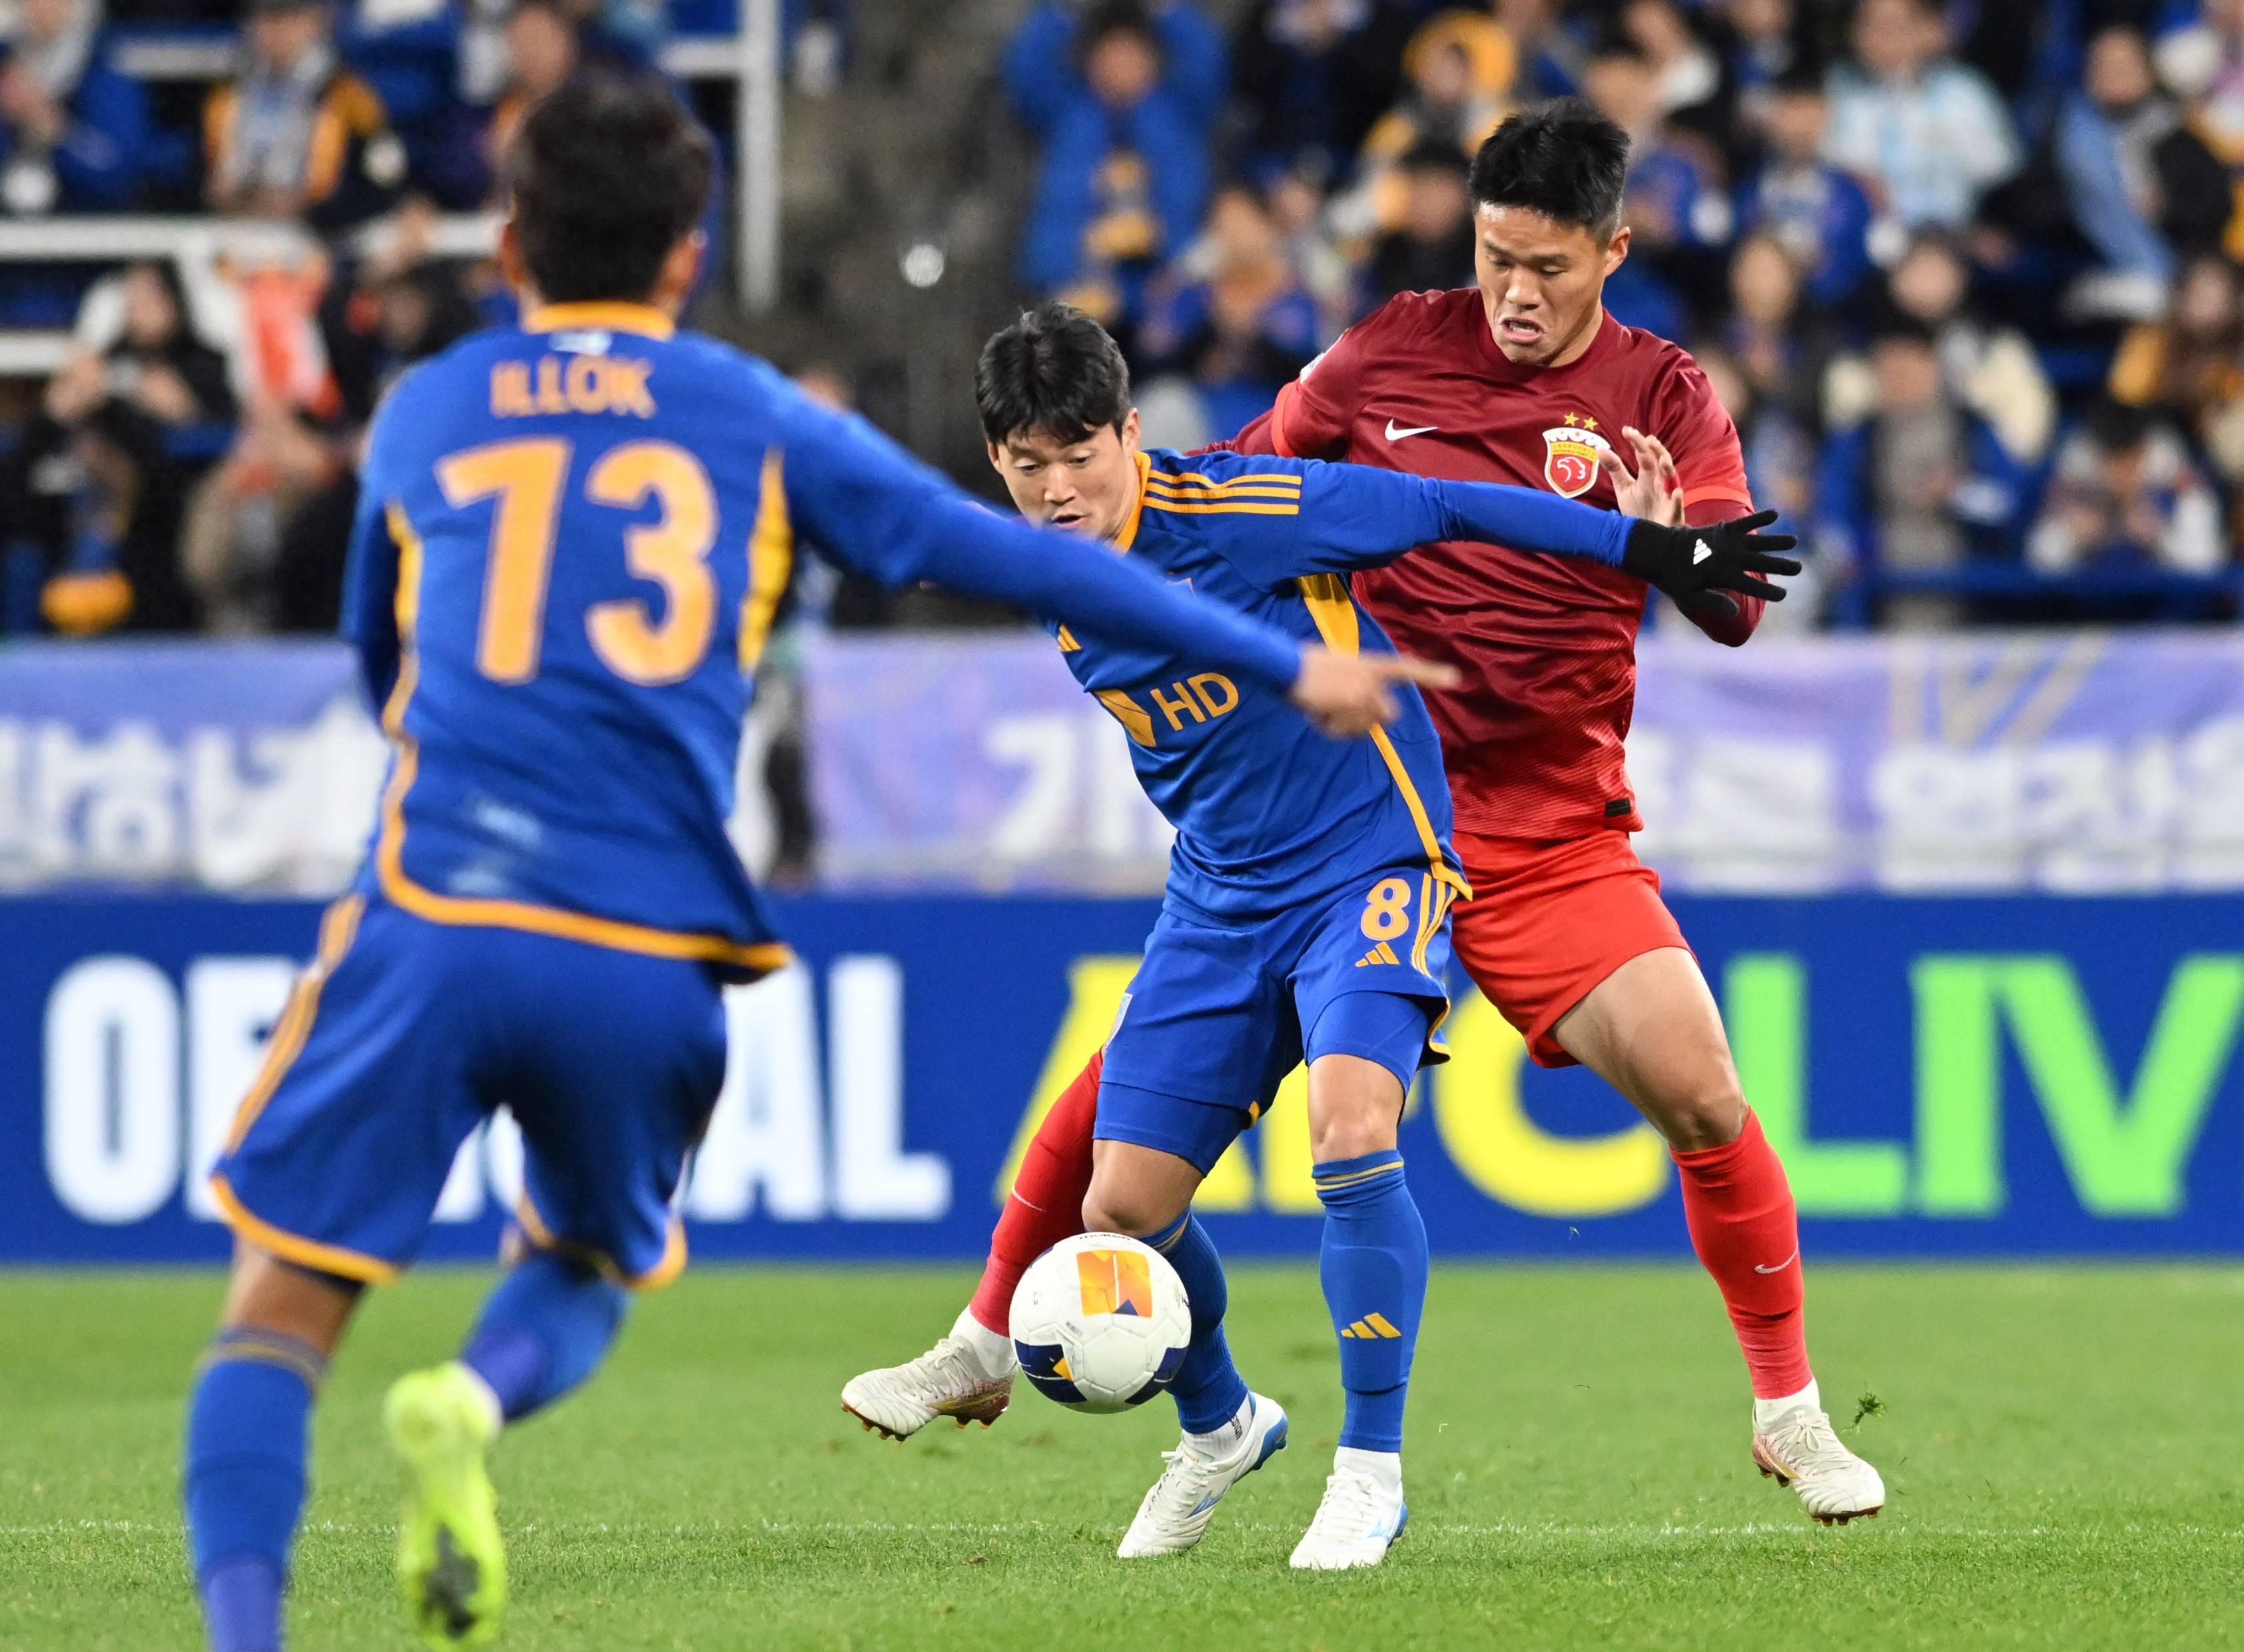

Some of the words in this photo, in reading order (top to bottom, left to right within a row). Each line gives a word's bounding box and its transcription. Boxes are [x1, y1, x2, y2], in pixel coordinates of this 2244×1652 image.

[434, 437, 720, 686] 73
[1150, 673, 1239, 731] HD
[1361, 878, 1411, 941] 8
